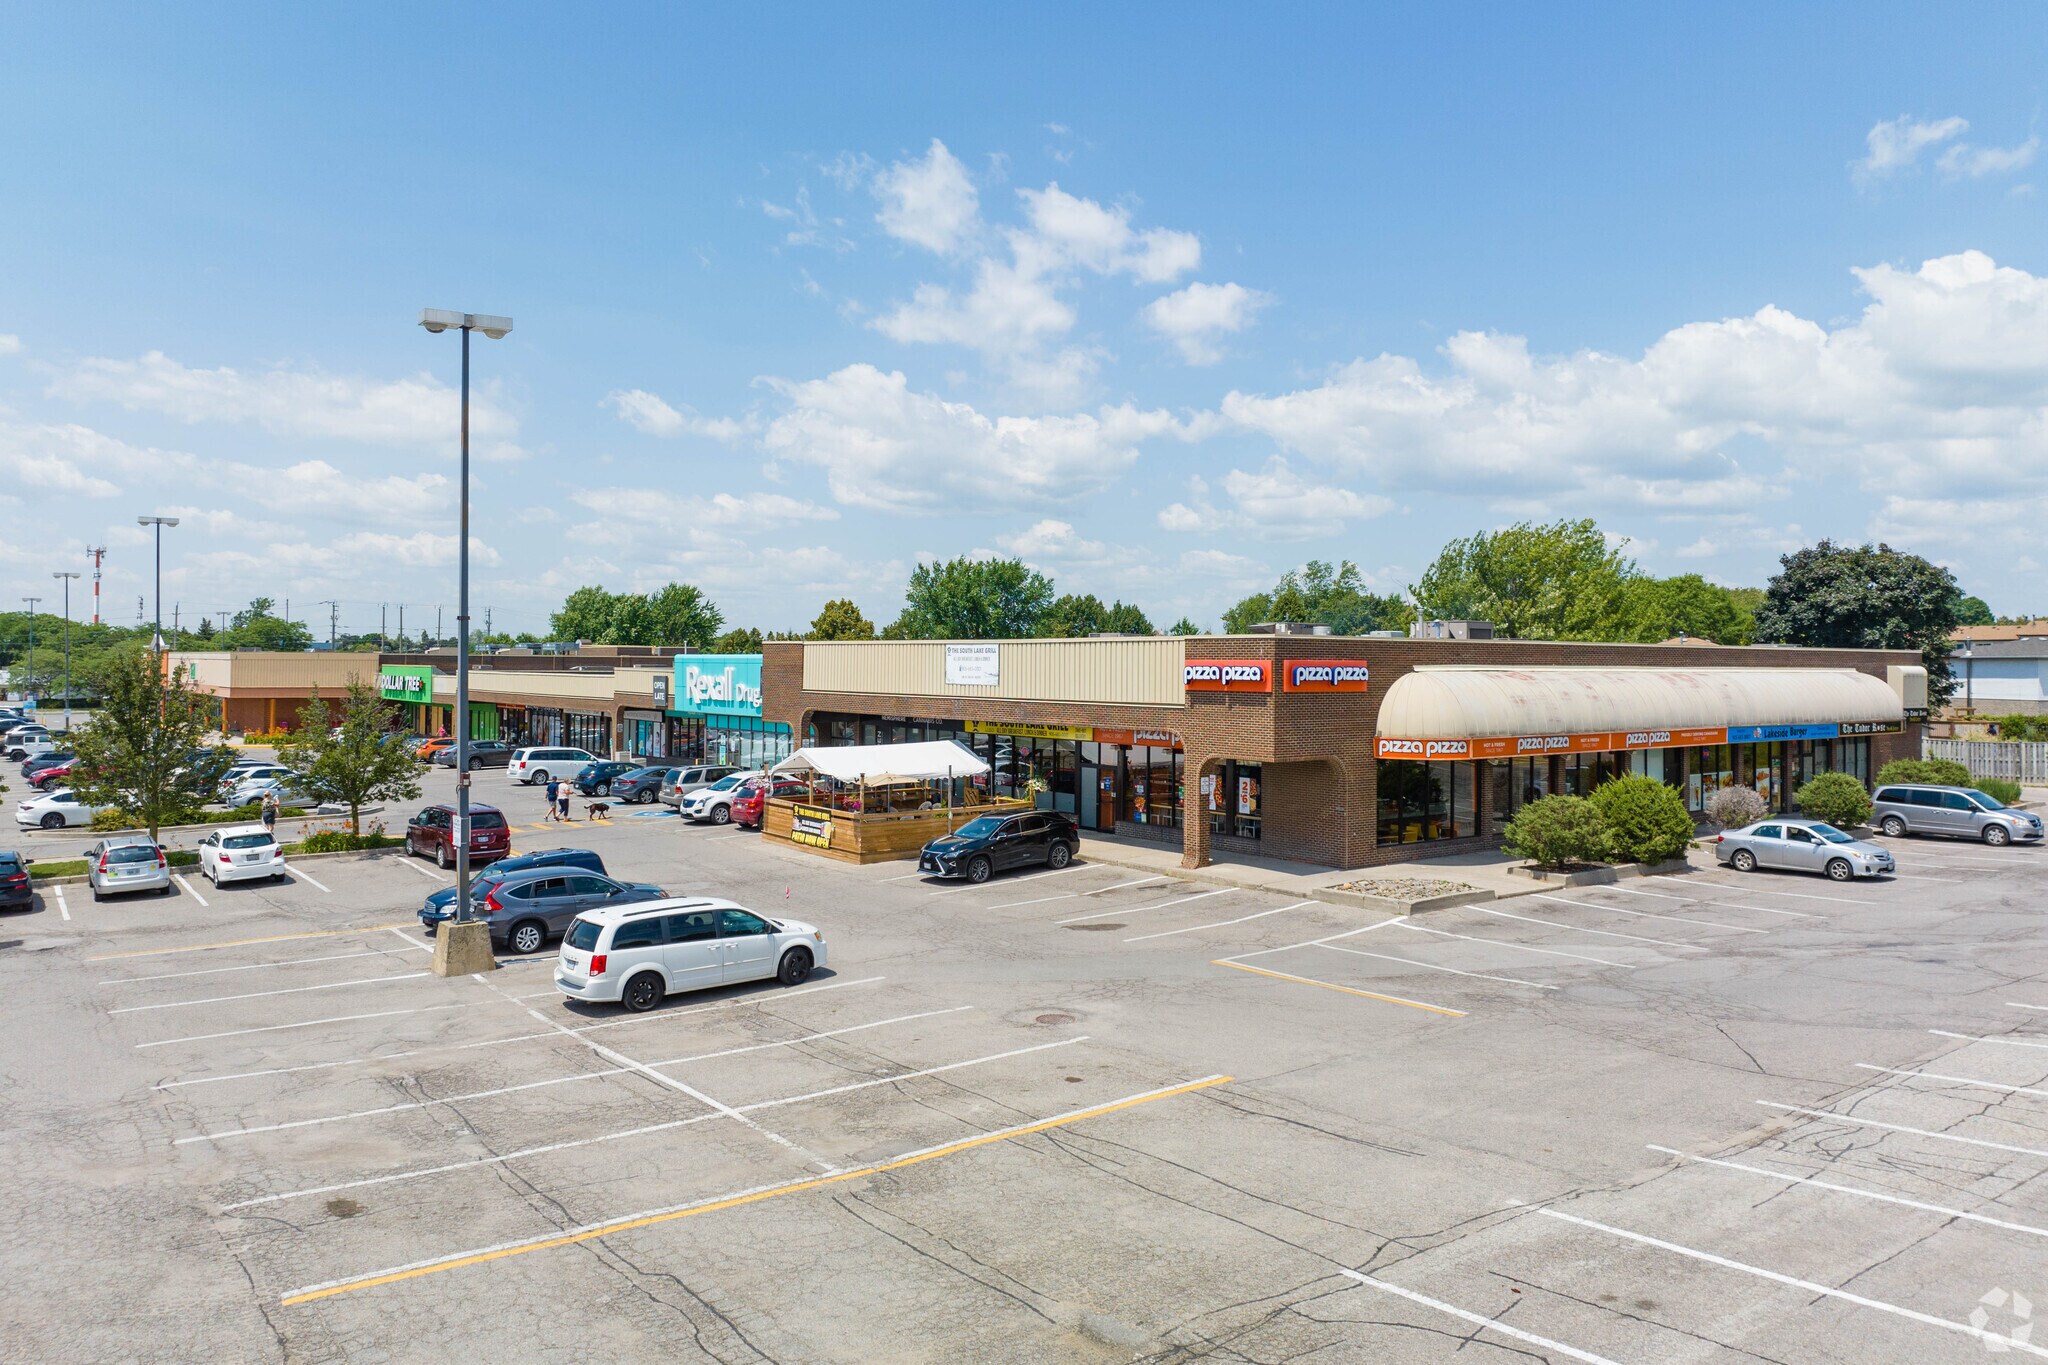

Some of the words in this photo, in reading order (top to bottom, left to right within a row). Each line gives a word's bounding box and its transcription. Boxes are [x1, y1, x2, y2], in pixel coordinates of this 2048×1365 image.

[382, 675, 404, 690] DOLLAR
[405, 676, 420, 691] TREE
[1184, 666, 1220, 685] pizza
[1222, 666, 1261, 685] pizza
[1296, 667, 1332, 686] pizza
[1334, 667, 1368, 686] pizza
[686, 666, 735, 704] Rexall
[736, 683, 762, 708] Drug
[1626, 733, 1648, 748] pizza
[1649, 732, 1670, 746] pizza
[1764, 729, 1788, 738] Lakeside
[1790, 727, 1807, 738] Burger
[1379, 740, 1424, 756] pizza
[1426, 741, 1467, 757] pizza
[1518, 738, 1543, 754] pizza
[1544, 736, 1569, 752] pizza
[1242, 782, 1248, 790] 2
